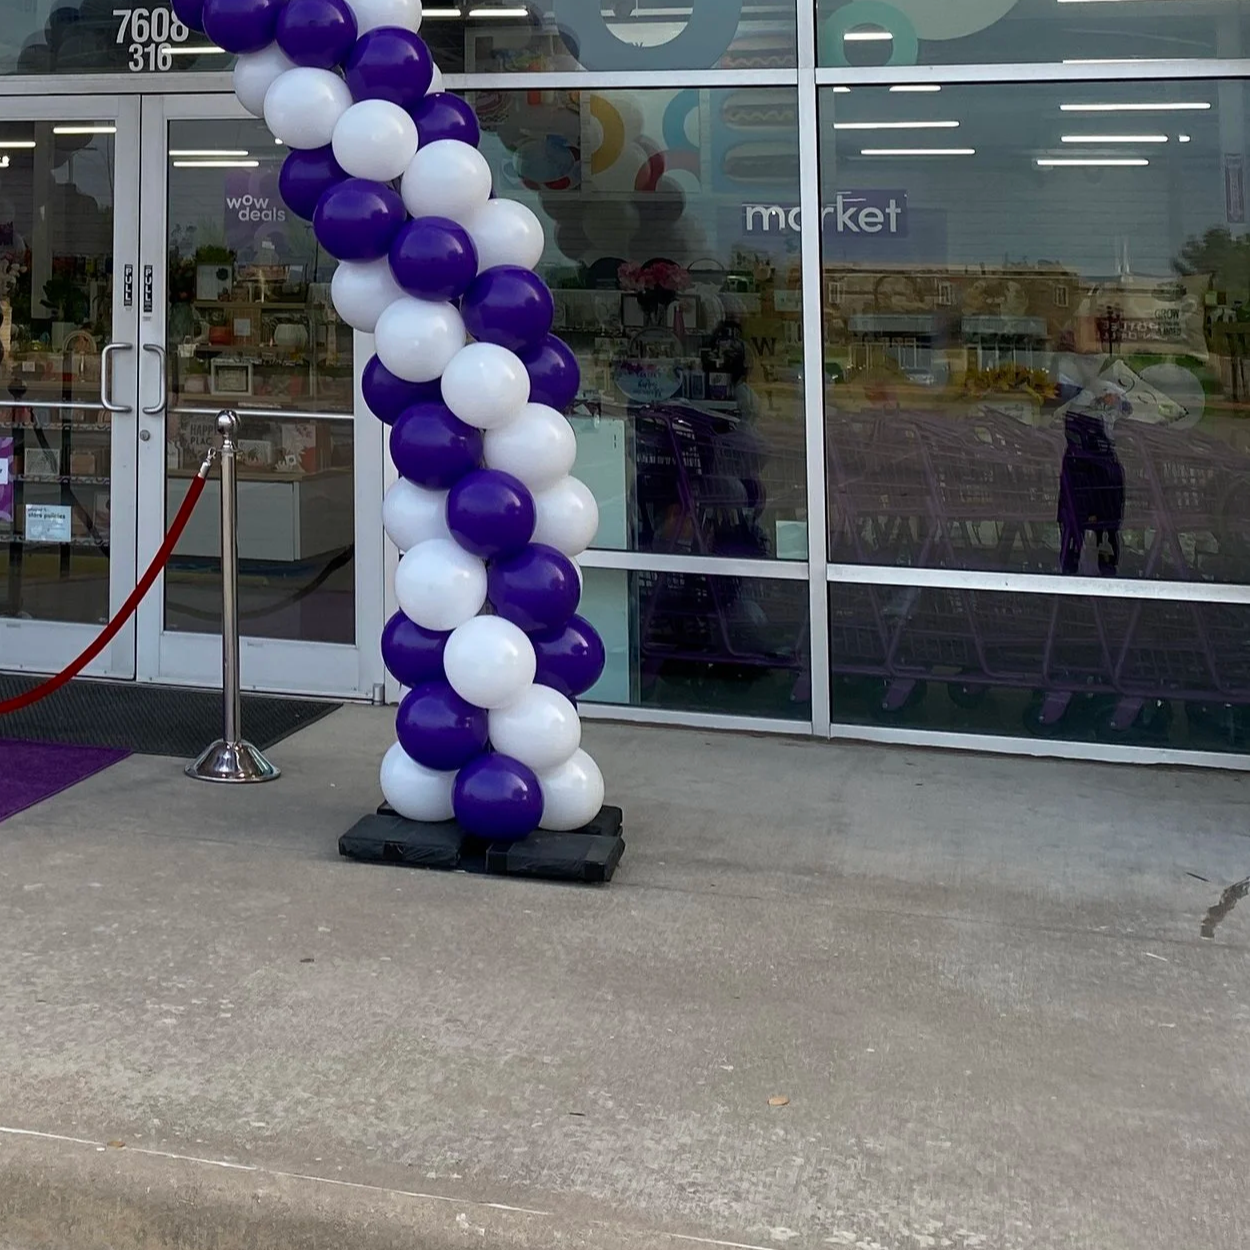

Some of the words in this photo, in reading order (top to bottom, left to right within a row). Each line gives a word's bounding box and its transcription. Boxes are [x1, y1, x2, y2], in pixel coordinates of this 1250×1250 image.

[113, 7, 189, 43] 7608
[129, 42, 172, 71] 316
[226, 194, 269, 209] wow
[238, 207, 286, 222] deals
[190, 424, 214, 436] HAPP
[190, 436, 212, 446] PLAC
